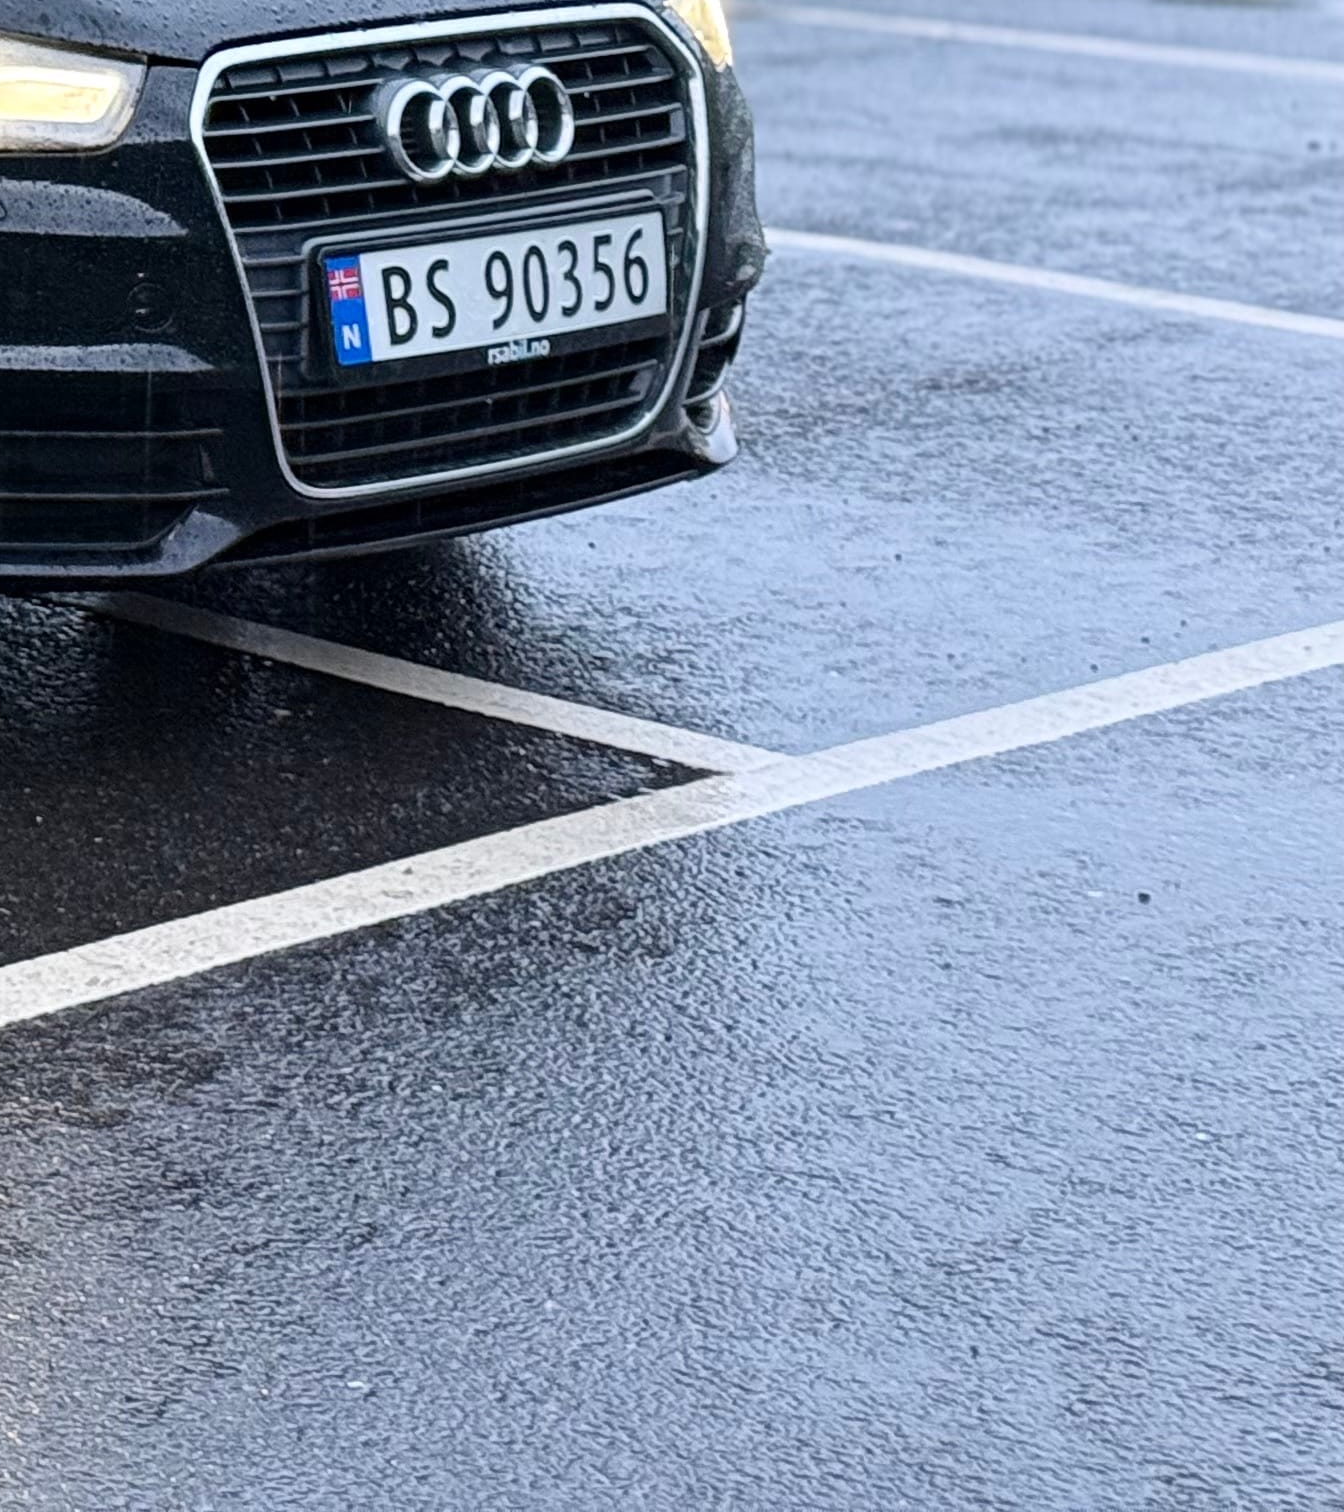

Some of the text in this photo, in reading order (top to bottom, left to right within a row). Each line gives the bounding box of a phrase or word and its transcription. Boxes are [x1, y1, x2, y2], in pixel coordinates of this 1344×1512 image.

[381, 227, 650, 347] BS 90356
[342, 323, 362, 351] N
